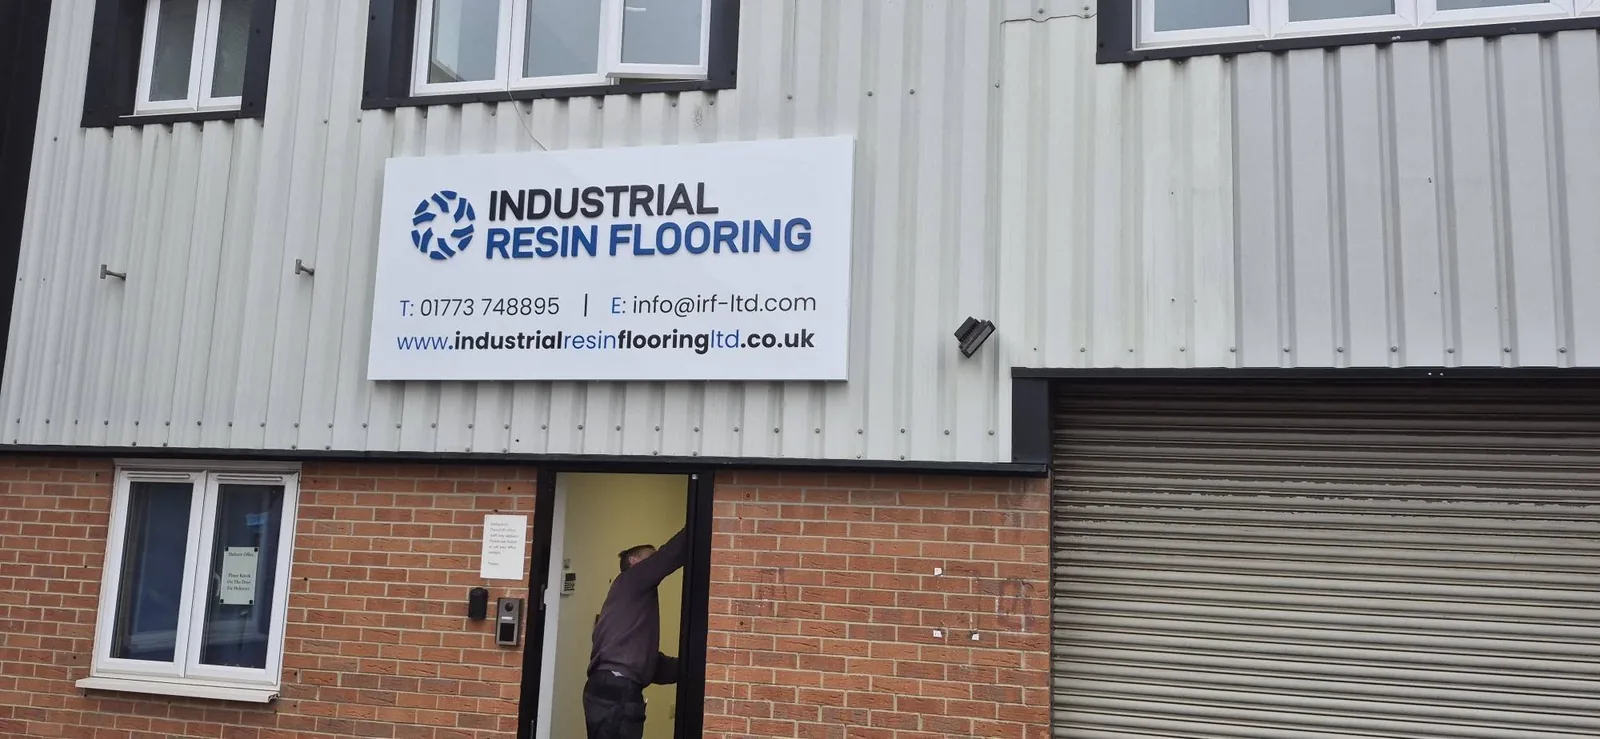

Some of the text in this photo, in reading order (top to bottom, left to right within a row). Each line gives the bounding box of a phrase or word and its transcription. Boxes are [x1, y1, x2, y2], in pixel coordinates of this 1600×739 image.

[488, 181, 719, 224] INDUSTRIAL
[485, 217, 813, 260] RESIN FLOORING
[399, 292, 818, 318] T: 01773 748895 E: info@irf-ltd.com
[396, 328, 816, 355] www.industrialresinflooringltd.co.uk
